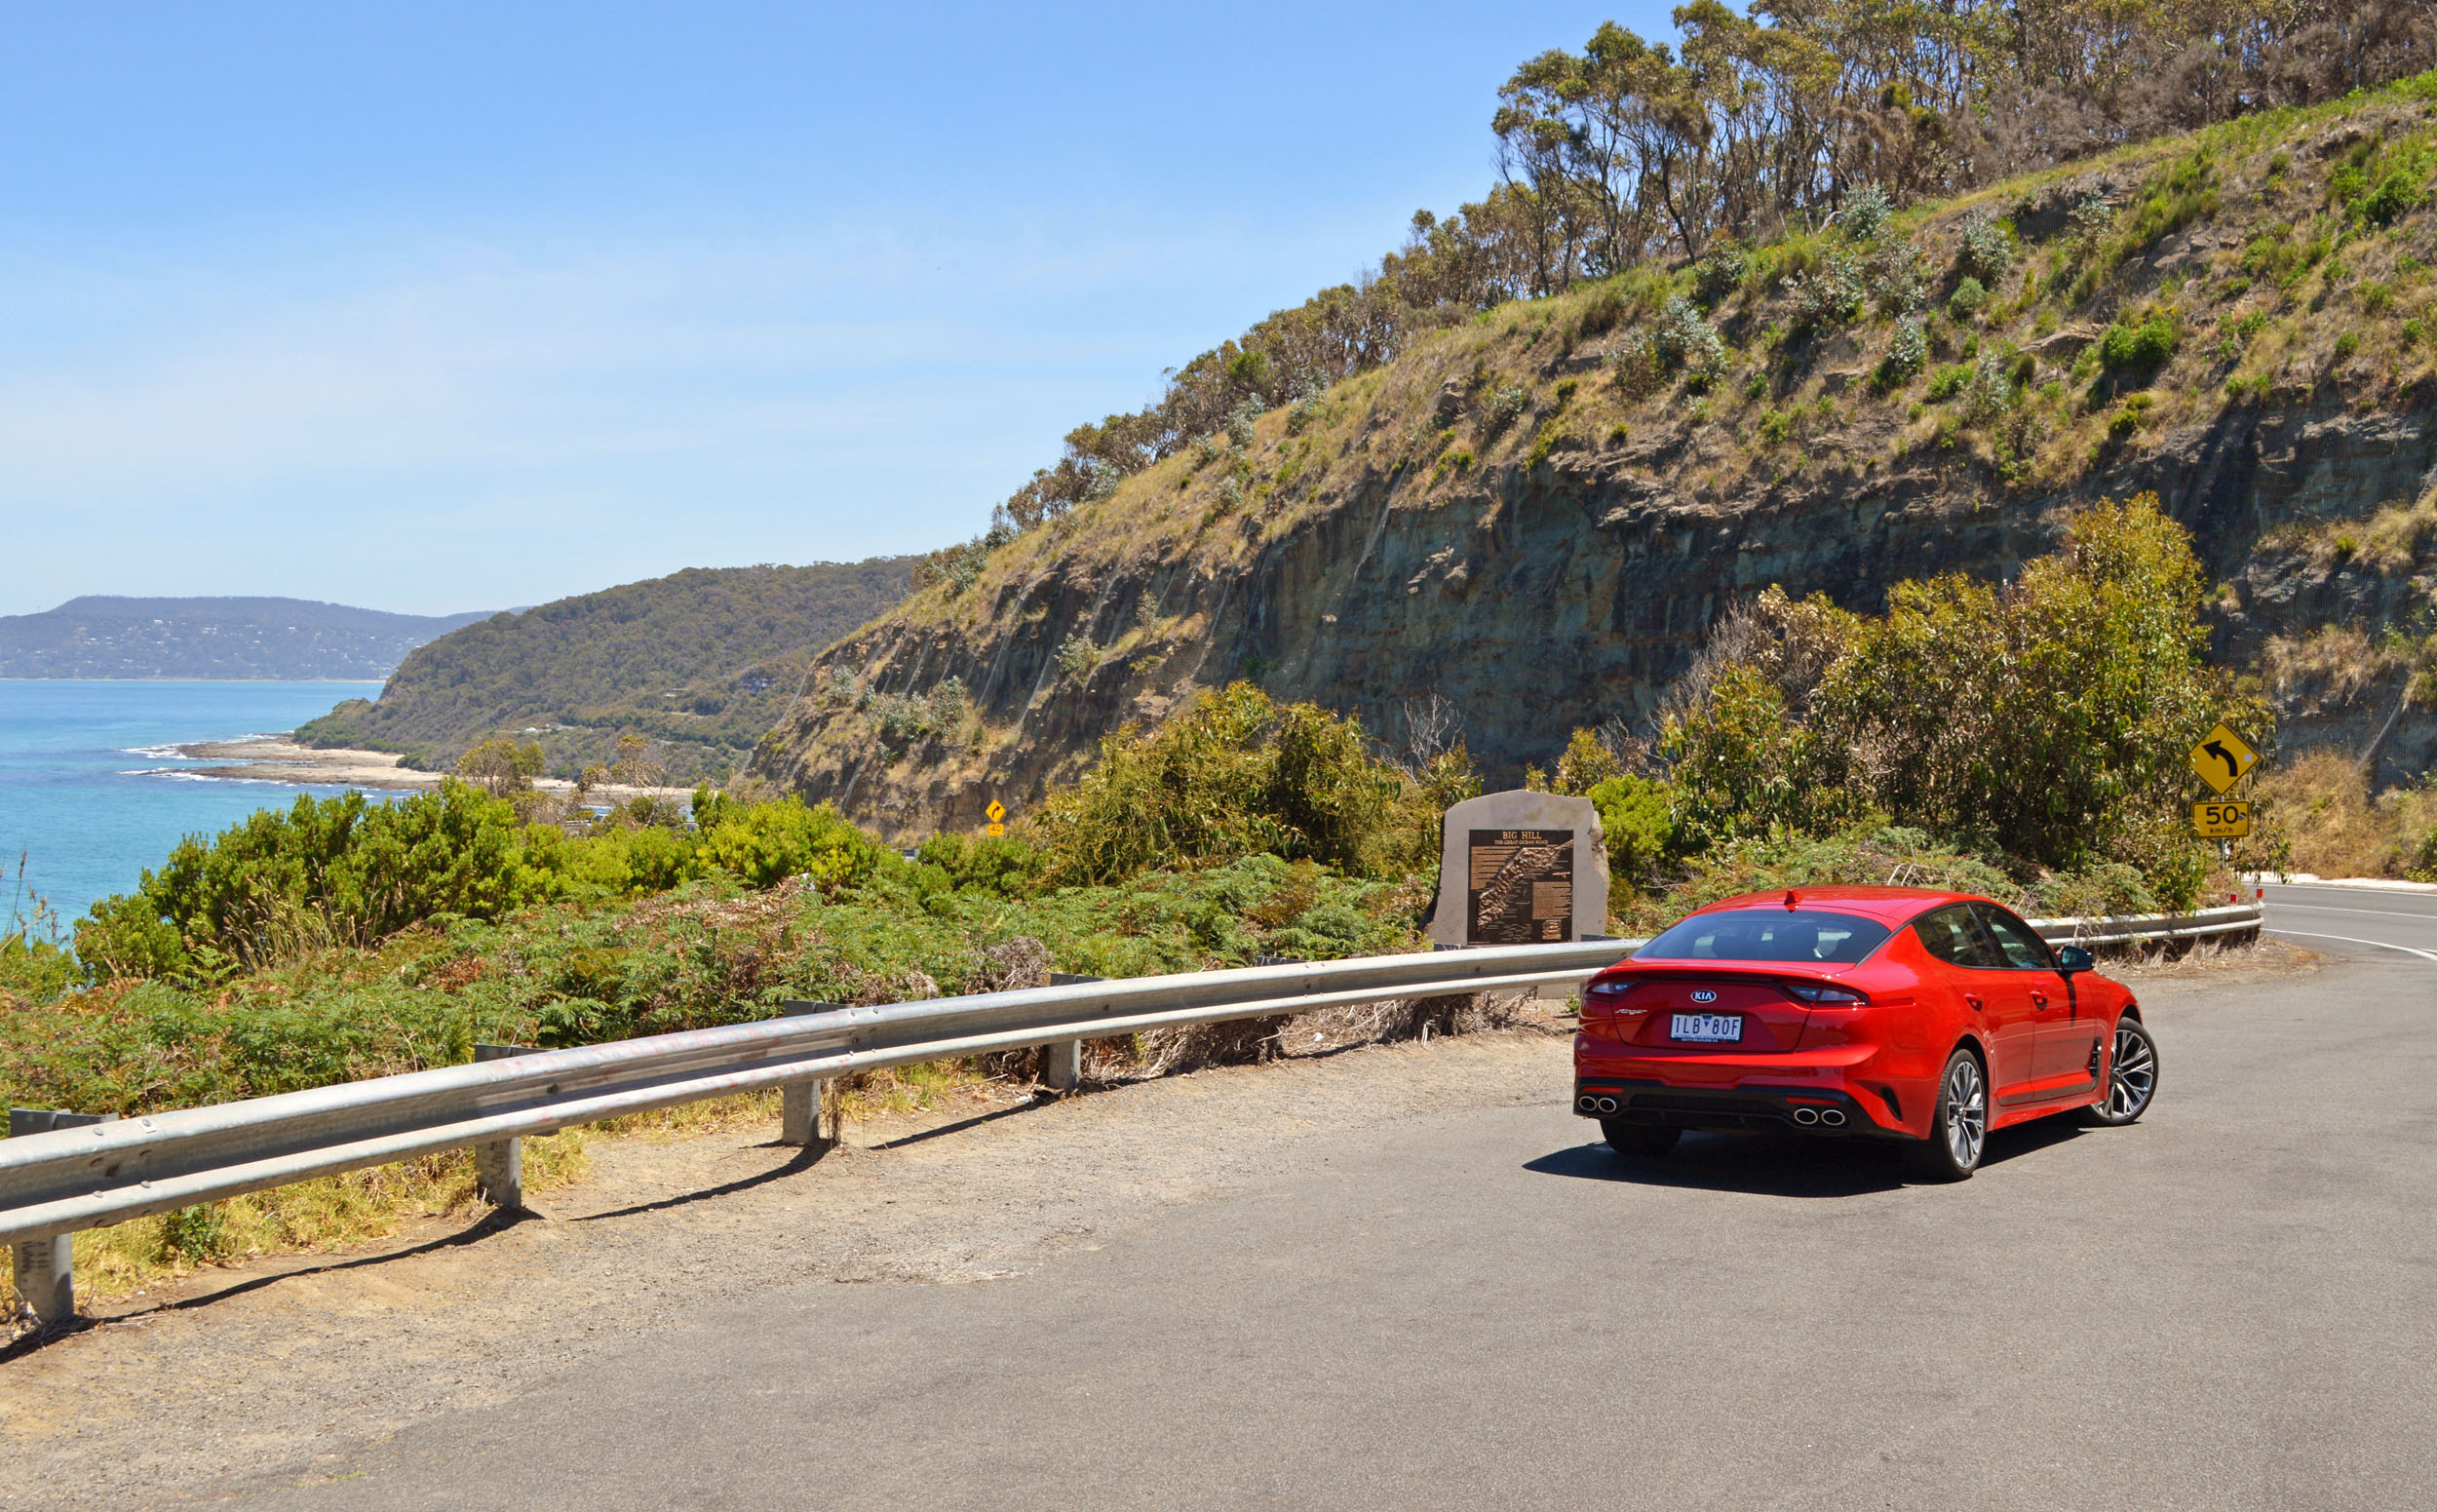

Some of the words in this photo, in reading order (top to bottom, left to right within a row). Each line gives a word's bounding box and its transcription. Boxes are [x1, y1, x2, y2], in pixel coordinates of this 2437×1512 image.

[2207, 805, 2238, 825] 50
[1502, 831, 1518, 839] BIG
[1521, 831, 1542, 839] HILL
[1694, 991, 1713, 1000] KIA
